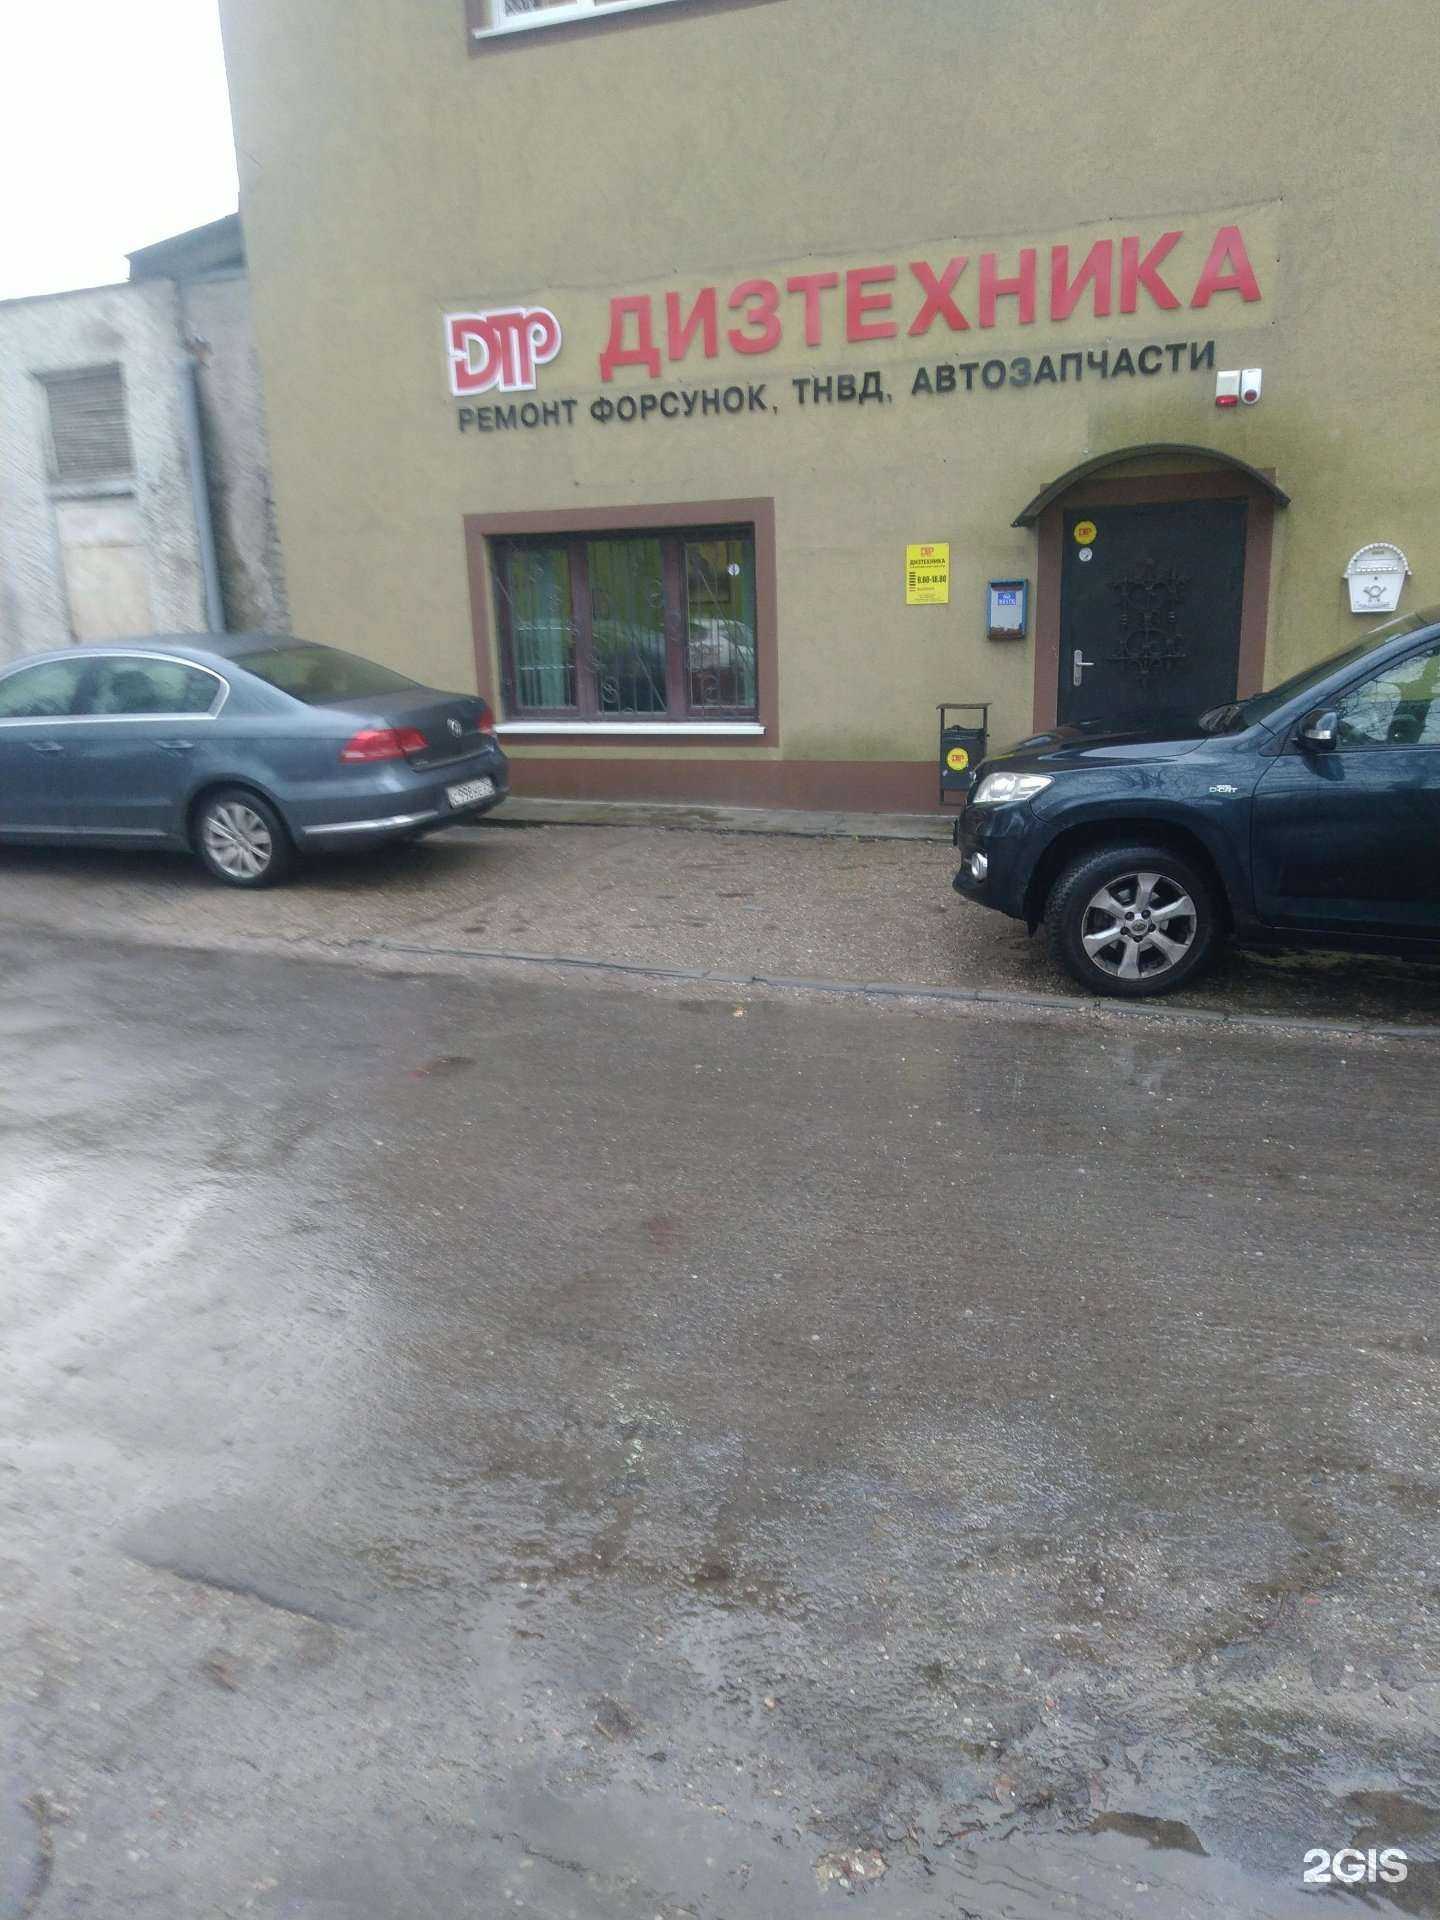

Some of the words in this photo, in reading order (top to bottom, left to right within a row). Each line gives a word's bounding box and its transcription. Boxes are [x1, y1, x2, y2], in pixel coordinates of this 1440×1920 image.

[600, 225, 1262, 382] ДИЗТЕХНИКА
[459, 399, 577, 432] РЕМОНТ
[591, 383, 779, 424] ФОРСУНОК,
[793, 370, 893, 407] ТНВД,
[912, 340, 1216, 395] АВТОЗАПЧАСТИ
